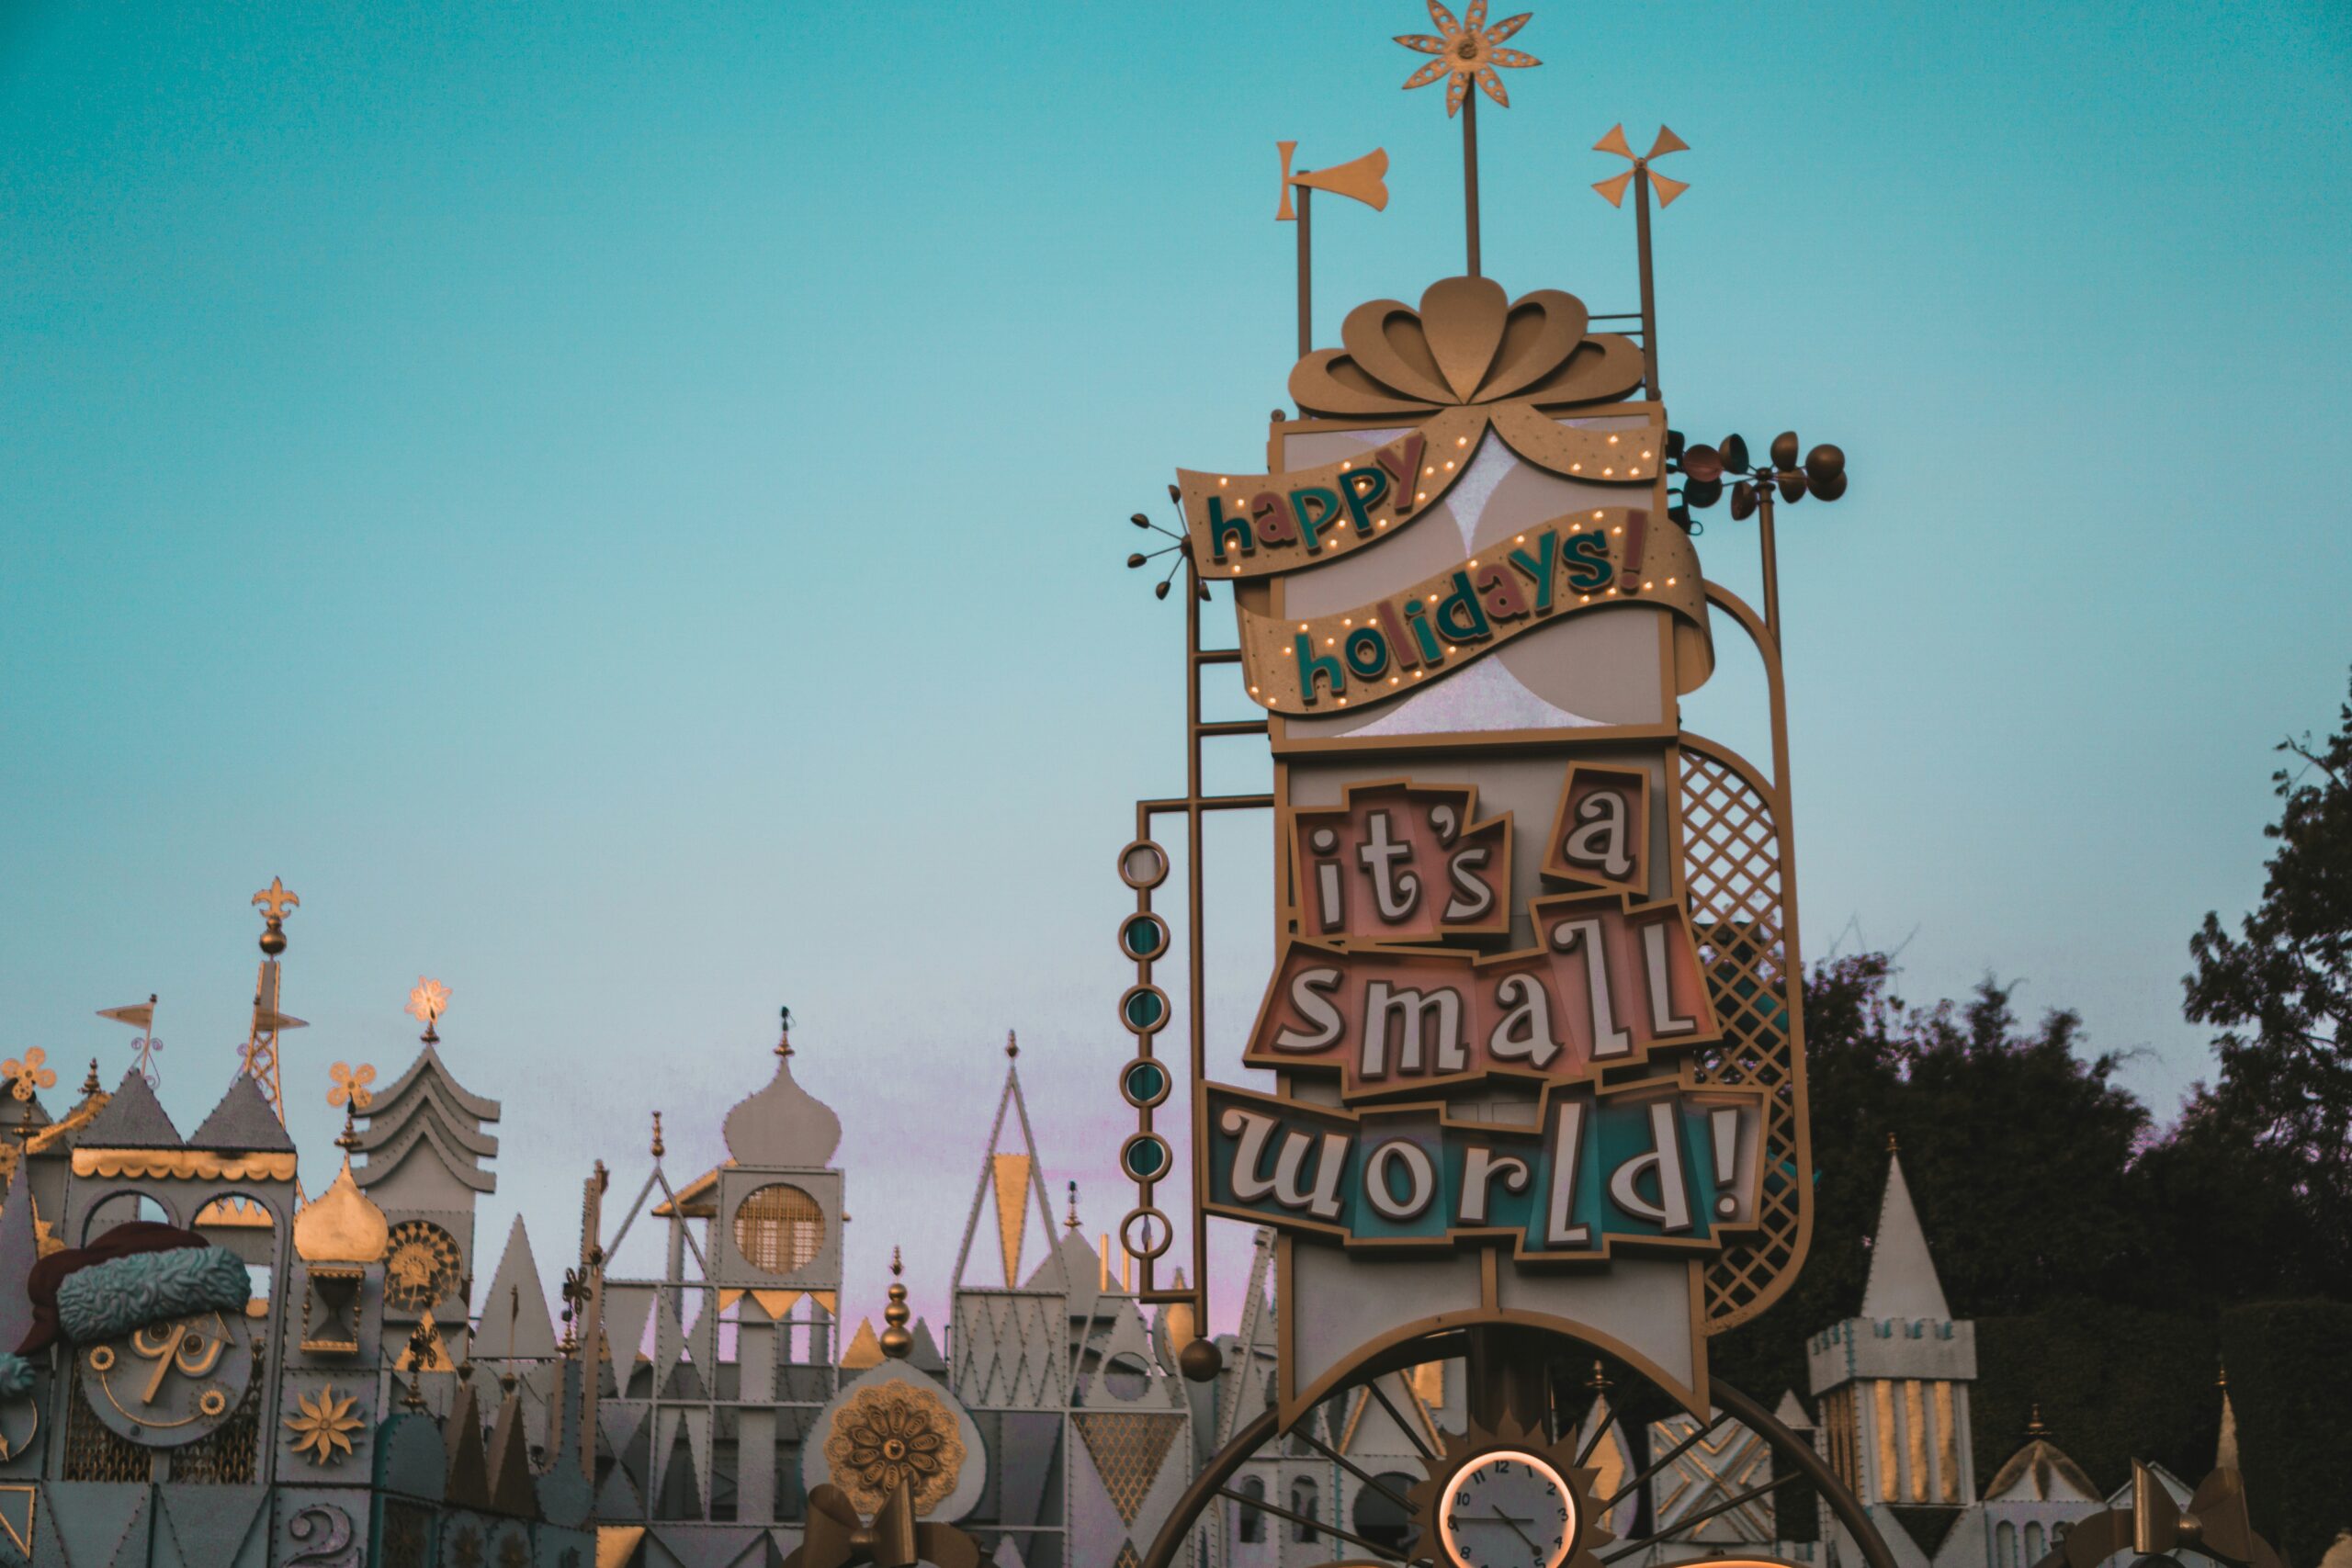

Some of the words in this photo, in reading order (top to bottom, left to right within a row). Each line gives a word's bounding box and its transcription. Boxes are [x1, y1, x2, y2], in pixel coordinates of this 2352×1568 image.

[1295, 509, 1648, 704] holidays!
[1310, 804, 1495, 930] it's
[1565, 788, 1634, 877] a
[1272, 916, 1698, 1081] small
[1219, 1102, 1741, 1246] world!
[1494, 1460, 1510, 1473] 12
[1471, 1469, 1486, 1484] 11
[1545, 1482, 1556, 1495] 2
[1456, 1492, 1470, 1506] 10
[1557, 1507, 1568, 1522] 3
[1554, 1535, 1563, 1550] 4
[1460, 1546, 1471, 1560] 8
